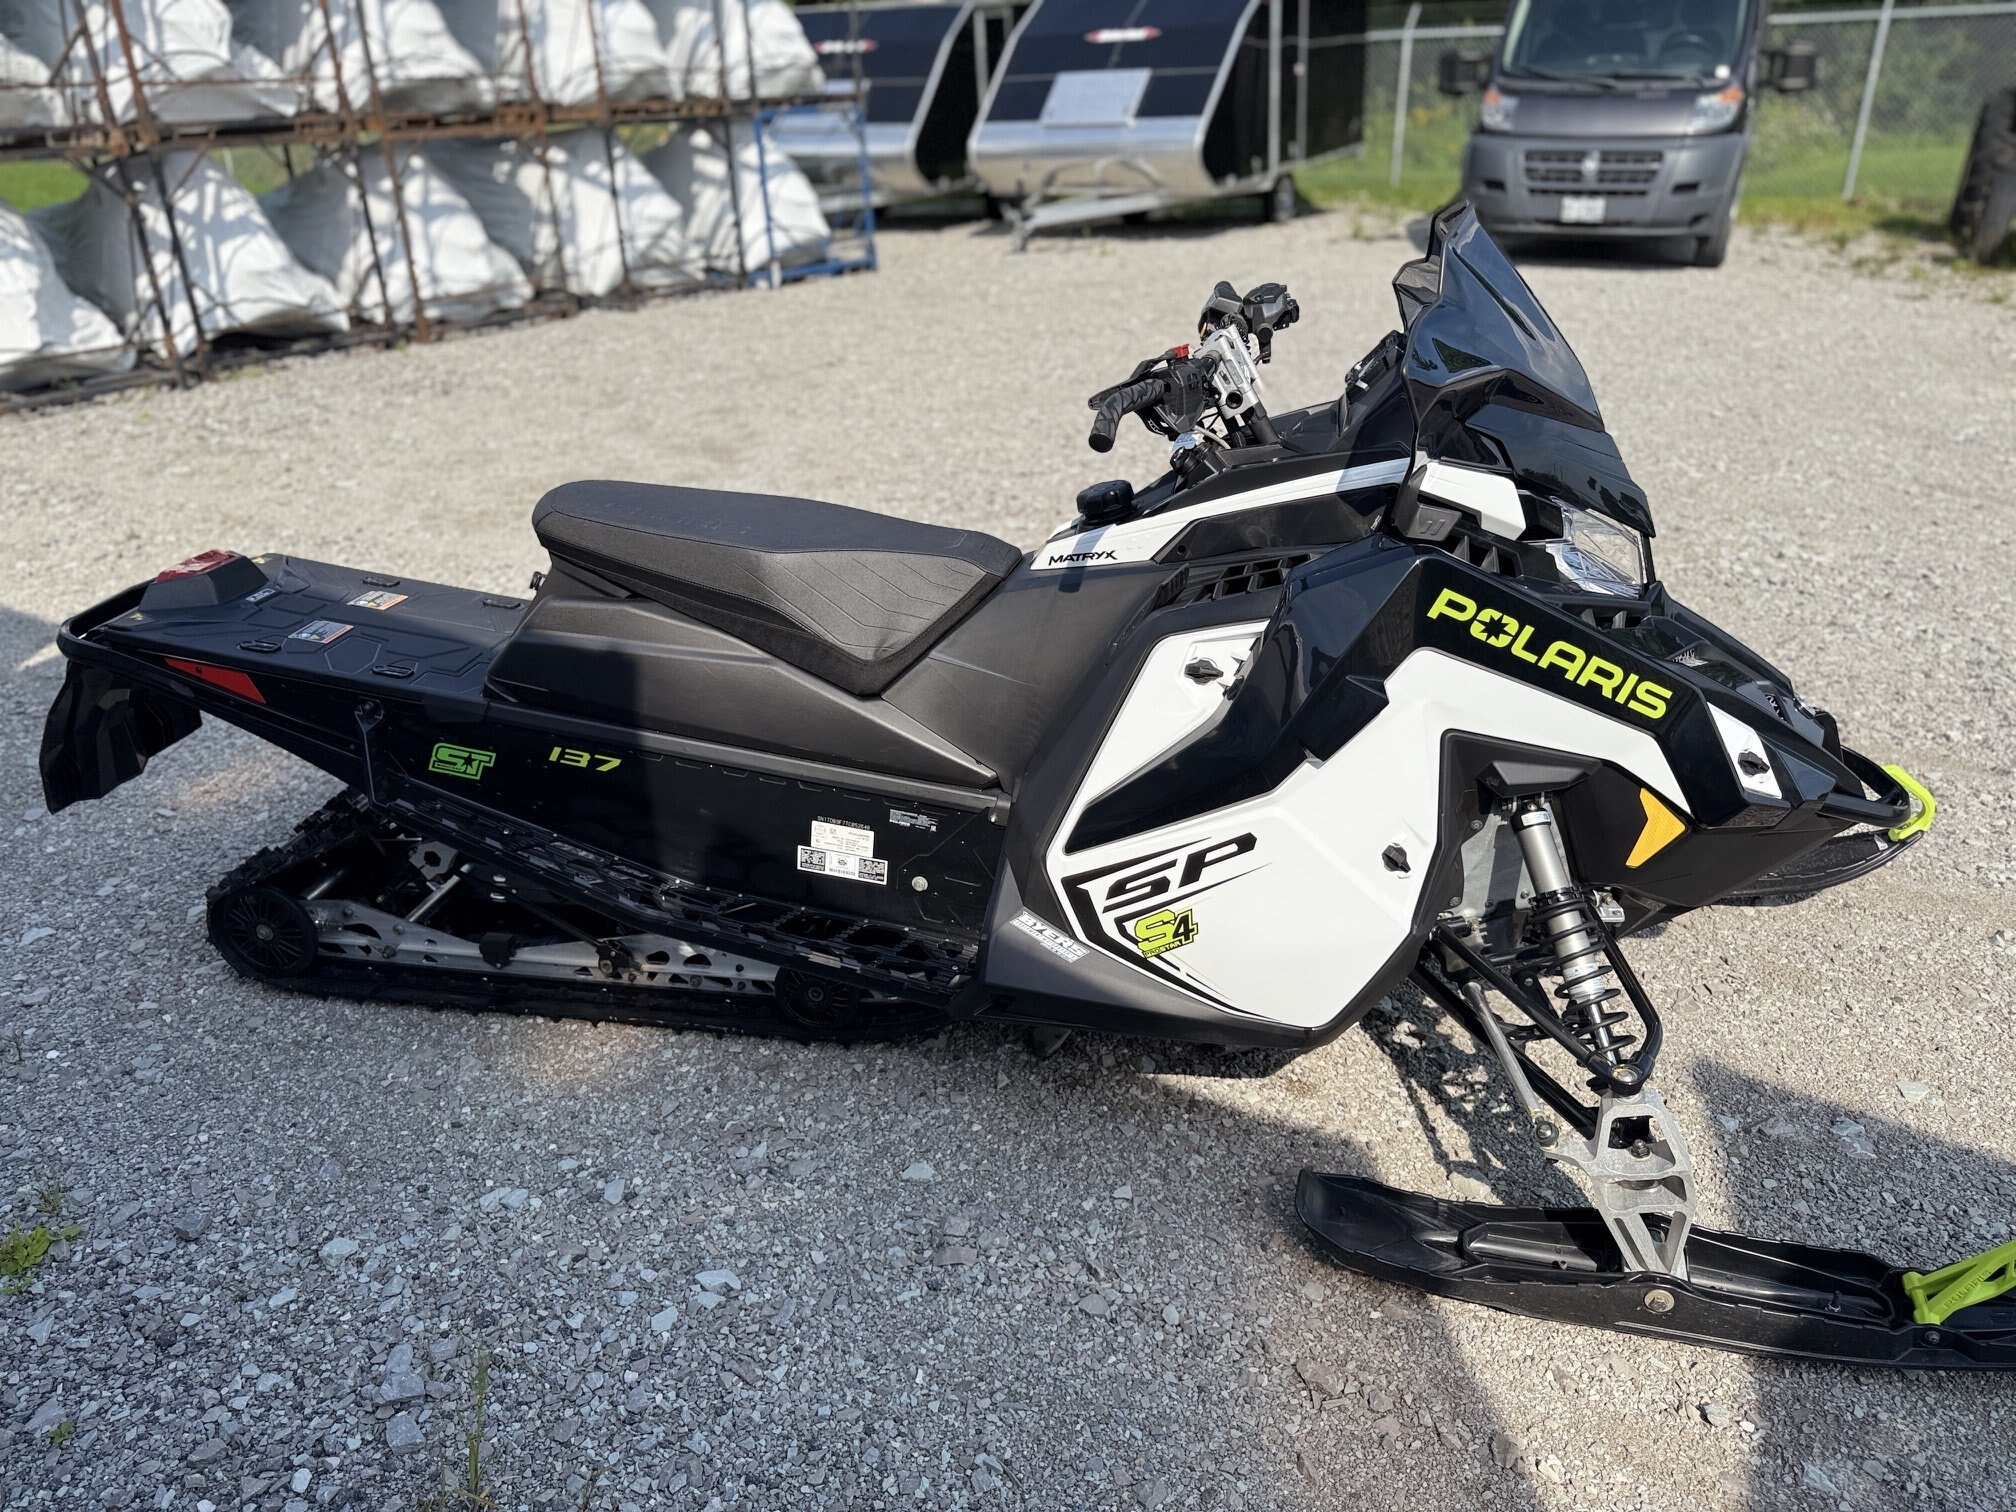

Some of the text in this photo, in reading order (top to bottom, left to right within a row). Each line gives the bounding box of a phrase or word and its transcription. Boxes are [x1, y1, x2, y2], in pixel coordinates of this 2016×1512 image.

[1048, 550, 1118, 566] MATRYX
[1426, 588, 1673, 719] POLARIS
[429, 745, 496, 779] ST
[549, 747, 622, 771] 137
[1102, 832, 1257, 913] SP
[1018, 911, 1088, 957] BYERS
[1134, 908, 1198, 953] S4
